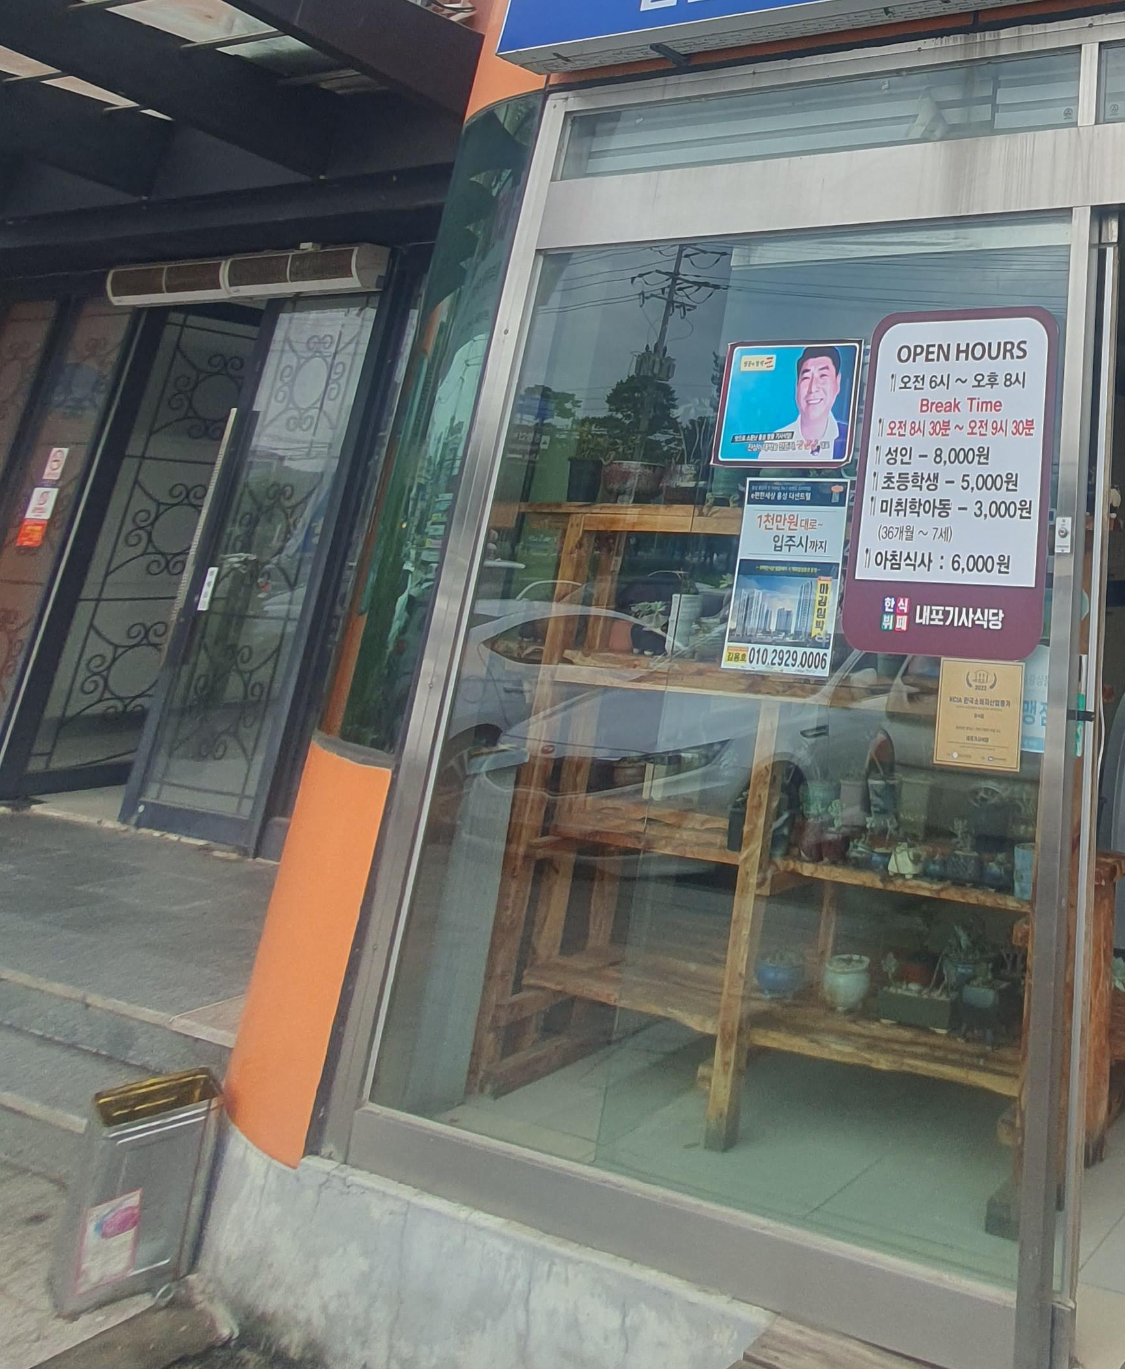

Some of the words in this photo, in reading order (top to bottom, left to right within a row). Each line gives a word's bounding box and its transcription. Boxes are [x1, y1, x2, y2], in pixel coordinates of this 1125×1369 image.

[896, 343, 951, 364] OPEN
[955, 340, 1028, 362] HOURS
[898, 374, 925, 391] 오전
[929, 373, 951, 391] 6시
[971, 372, 999, 390] 오후
[1003, 371, 1026, 389] 8시
[919, 398, 961, 414] Break
[966, 397, 1003, 413] Time
[886, 420, 907, 437] 오전
[909, 420, 926, 438] 8시
[928, 420, 951, 438] 30분
[966, 419, 988, 437] 오전
[991, 419, 1008, 438] 9시
[1011, 418, 1035, 437] 30분
[885, 446, 913, 466] 성인
[933, 446, 990, 467] 8,000원
[881, 472, 939, 492] 초등학생
[960, 472, 1019, 493] 5,000원
[880, 497, 951, 519] 미취학아동
[973, 499, 1033, 520] 3,000원
[877, 524, 915, 542] (36개월
[931, 526, 953, 543] 7세)
[874, 550, 933, 572] 아침식사
[951, 554, 1011, 575] 6,000원
[915, 605, 1004, 630] 내포기사식당
[748, 647, 828, 670] 010.2929.0006
